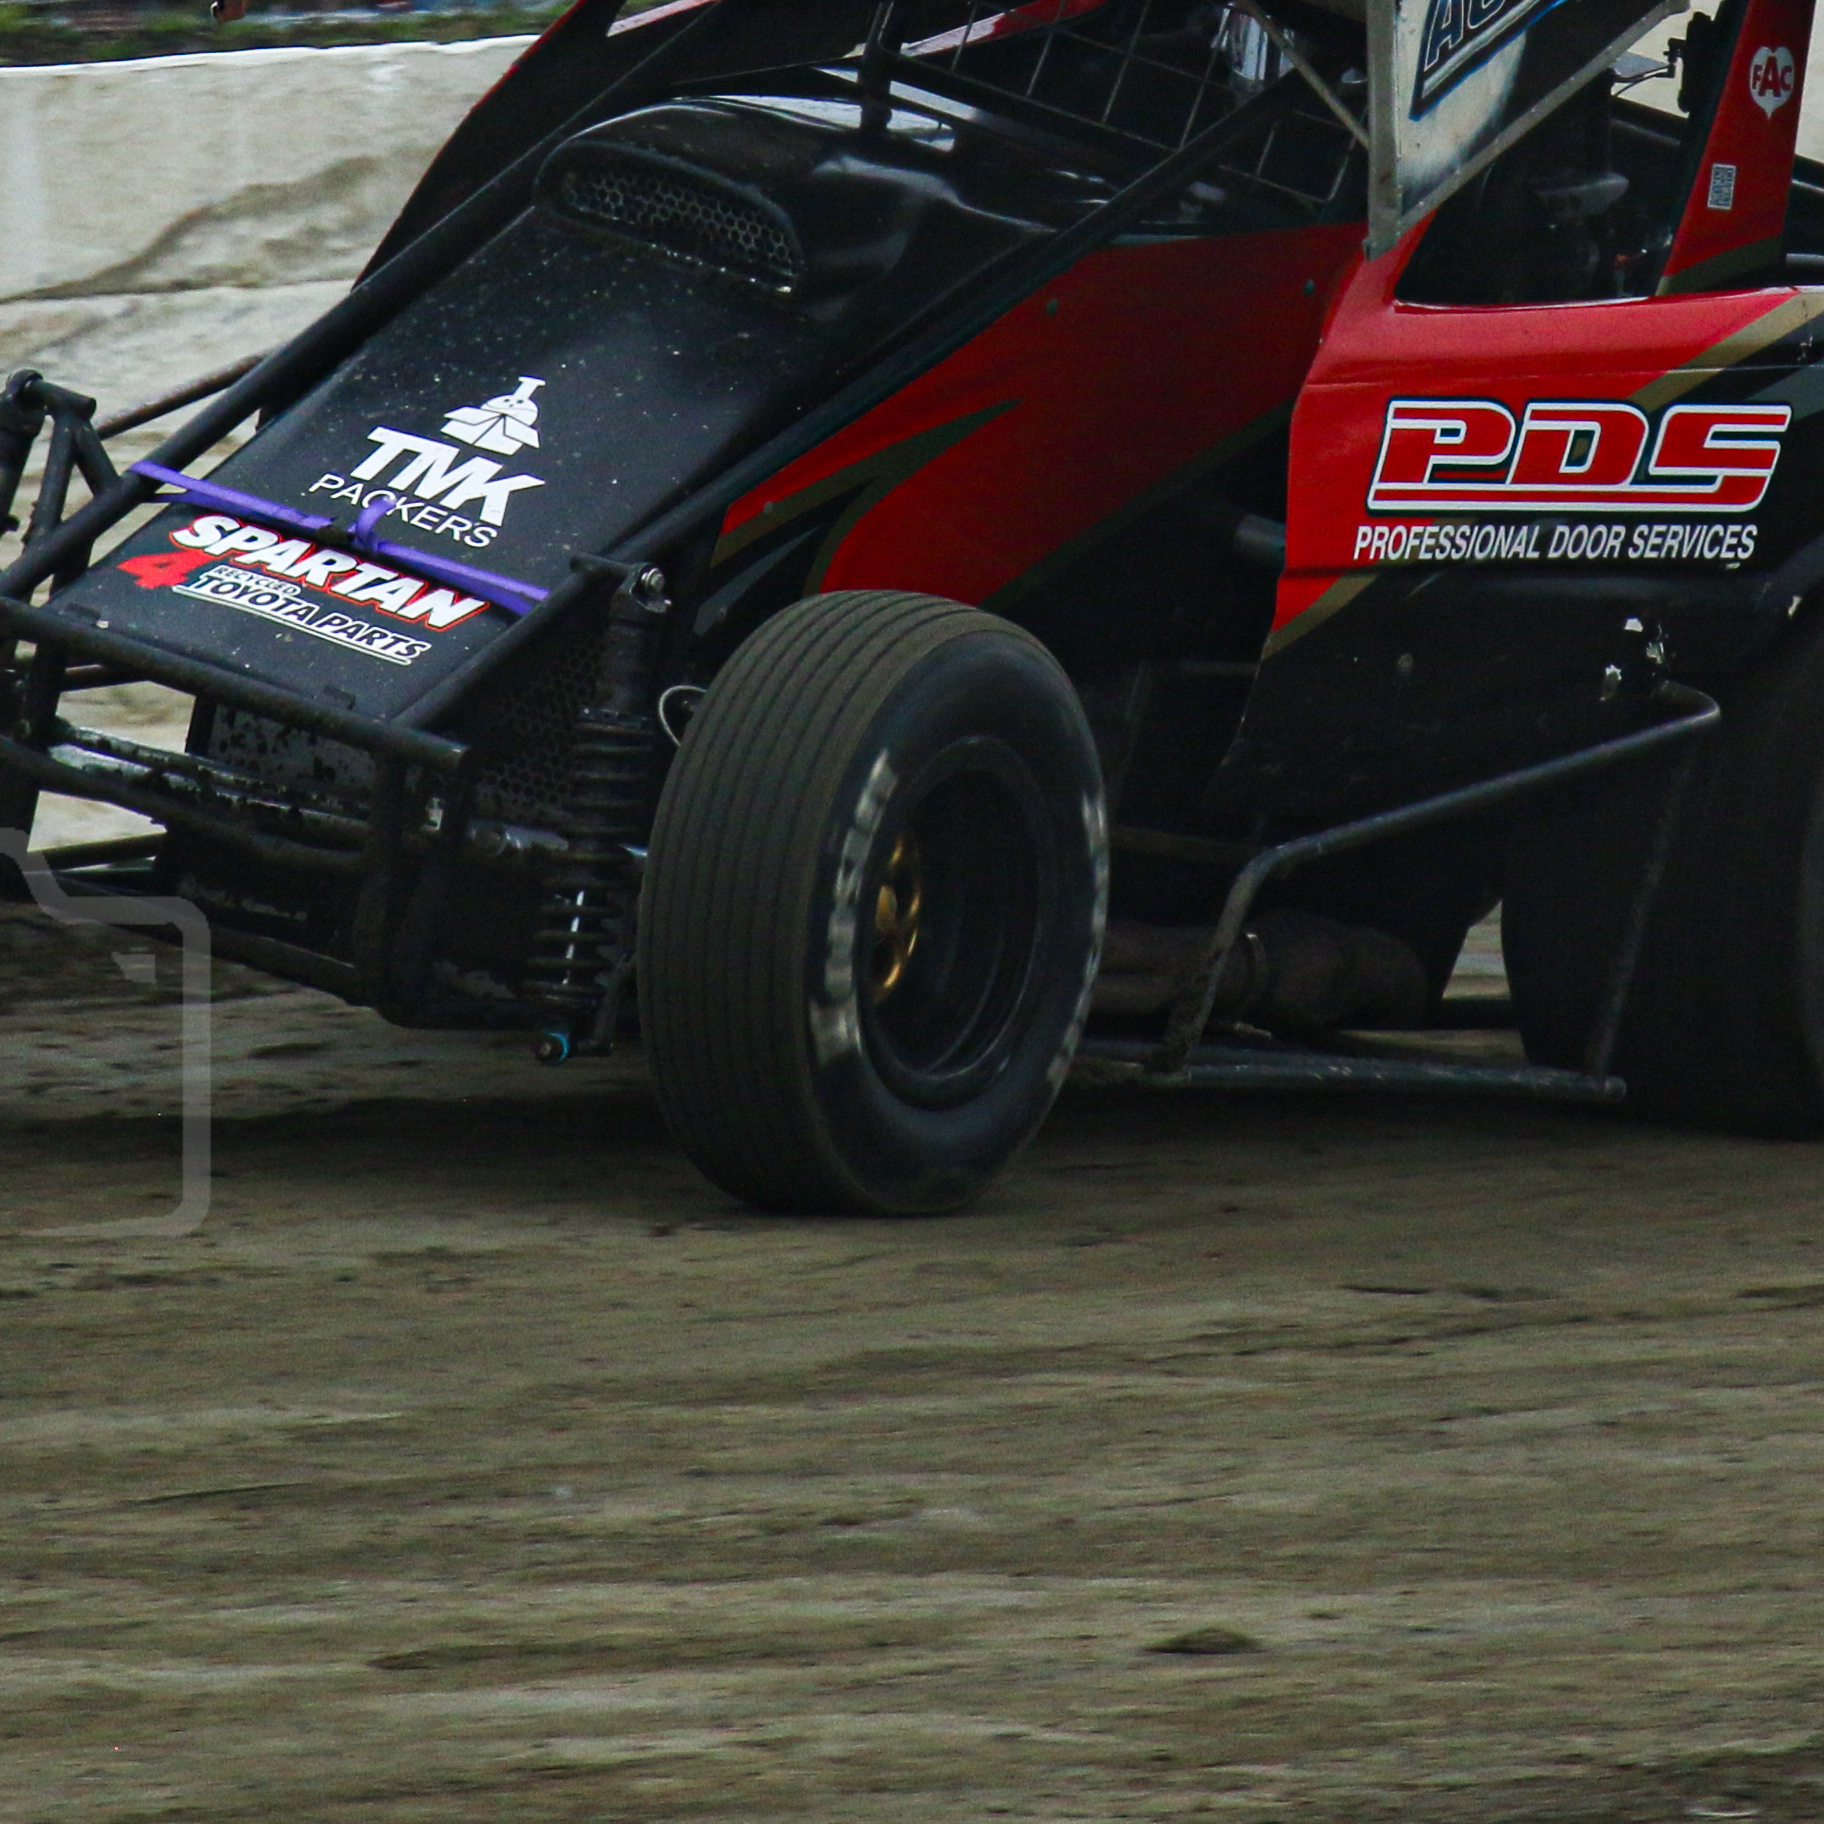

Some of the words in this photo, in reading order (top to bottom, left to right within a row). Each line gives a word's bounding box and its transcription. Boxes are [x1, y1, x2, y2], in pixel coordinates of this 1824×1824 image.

[1751, 55, 1794, 99] FAC
[349, 425, 546, 528] TMK
[1367, 400, 1793, 513] PDS
[308, 473, 499, 549] PACKERS
[1352, 525, 1541, 561] PROFESSIONAL
[1547, 525, 1626, 560] DOOR
[1627, 524, 1759, 561] SERVICES
[171, 513, 485, 629] SPARTAN
[213, 565, 299, 596] RECYCLED
[194, 575, 318, 627] TOYOTA
[318, 614, 430, 659] PARTS
